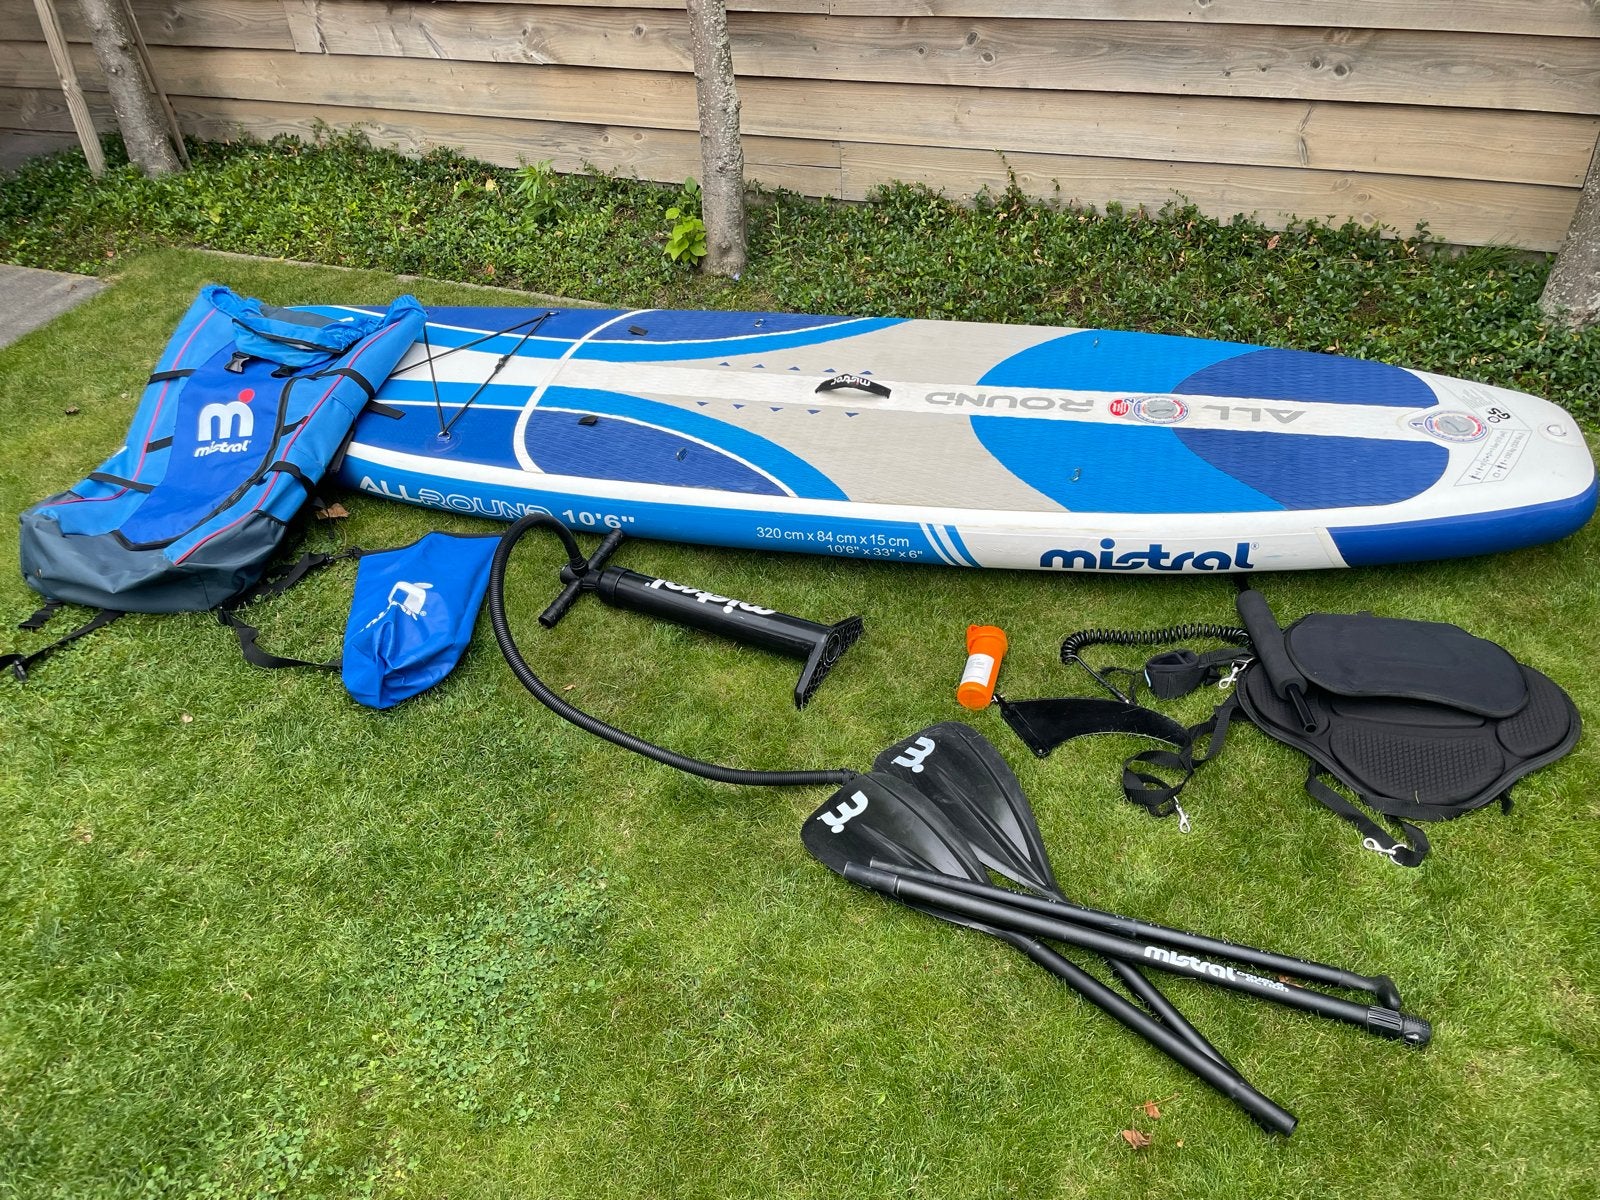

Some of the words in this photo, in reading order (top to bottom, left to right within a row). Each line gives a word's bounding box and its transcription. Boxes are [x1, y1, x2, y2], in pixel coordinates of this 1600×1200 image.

[924, 391, 1094, 413] ROUND
[1203, 404, 1308, 424] ALL
[193, 440, 249, 458] mistral
[562, 509, 634, 529] 10'6"
[756, 526, 781, 539] 320
[784, 530, 804, 541] cm
[807, 533, 815, 541] x
[816, 530, 833, 543] 84
[836, 533, 857, 544] cm
[859, 536, 868, 545] x
[869, 534, 885, 546] 15
[888, 537, 910, 548] cm
[826, 544, 859, 554] 10'6"
[873, 547, 895, 557] 33"
[898, 550, 907, 558] x
[908, 550, 923, 559] 6"
[1040, 538, 1254, 570] mistral
[1144, 945, 1236, 982] mistral
